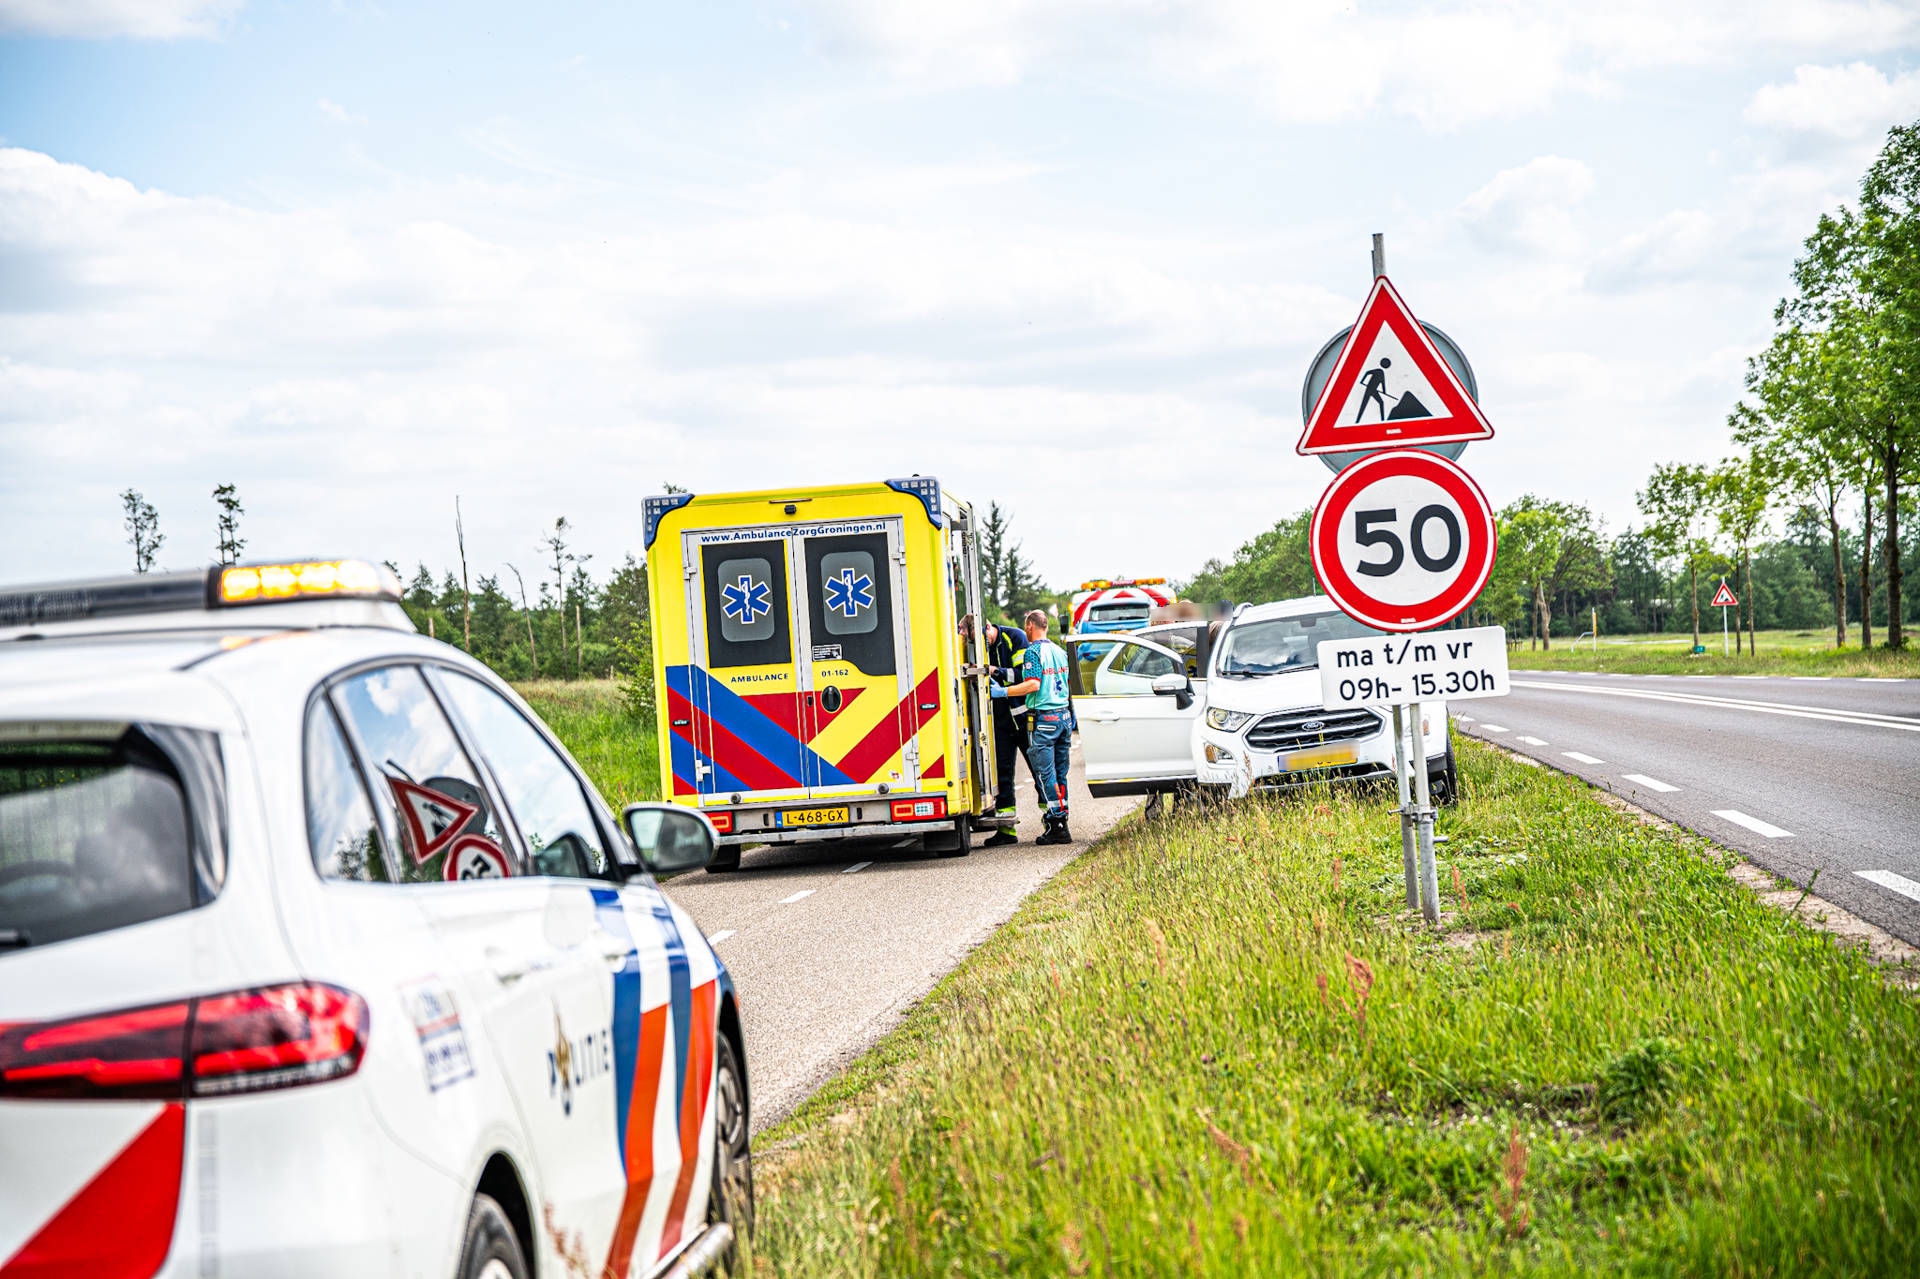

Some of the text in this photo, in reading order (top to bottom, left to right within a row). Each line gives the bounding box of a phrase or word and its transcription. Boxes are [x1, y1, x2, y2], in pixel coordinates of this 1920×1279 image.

[701, 522, 887, 543] www.AmbulanceZorgGroningen.nl
[1354, 504, 1462, 577] 50
[1337, 639, 1473, 668] ma t/m vr
[731, 673, 789, 683] AMBULANCE
[821, 669, 849, 677] 01-162
[1339, 669, 1495, 701] 09h- 15.30h
[786, 809, 844, 825] L-468-GX
[547, 1028, 610, 1102] PLITIE
